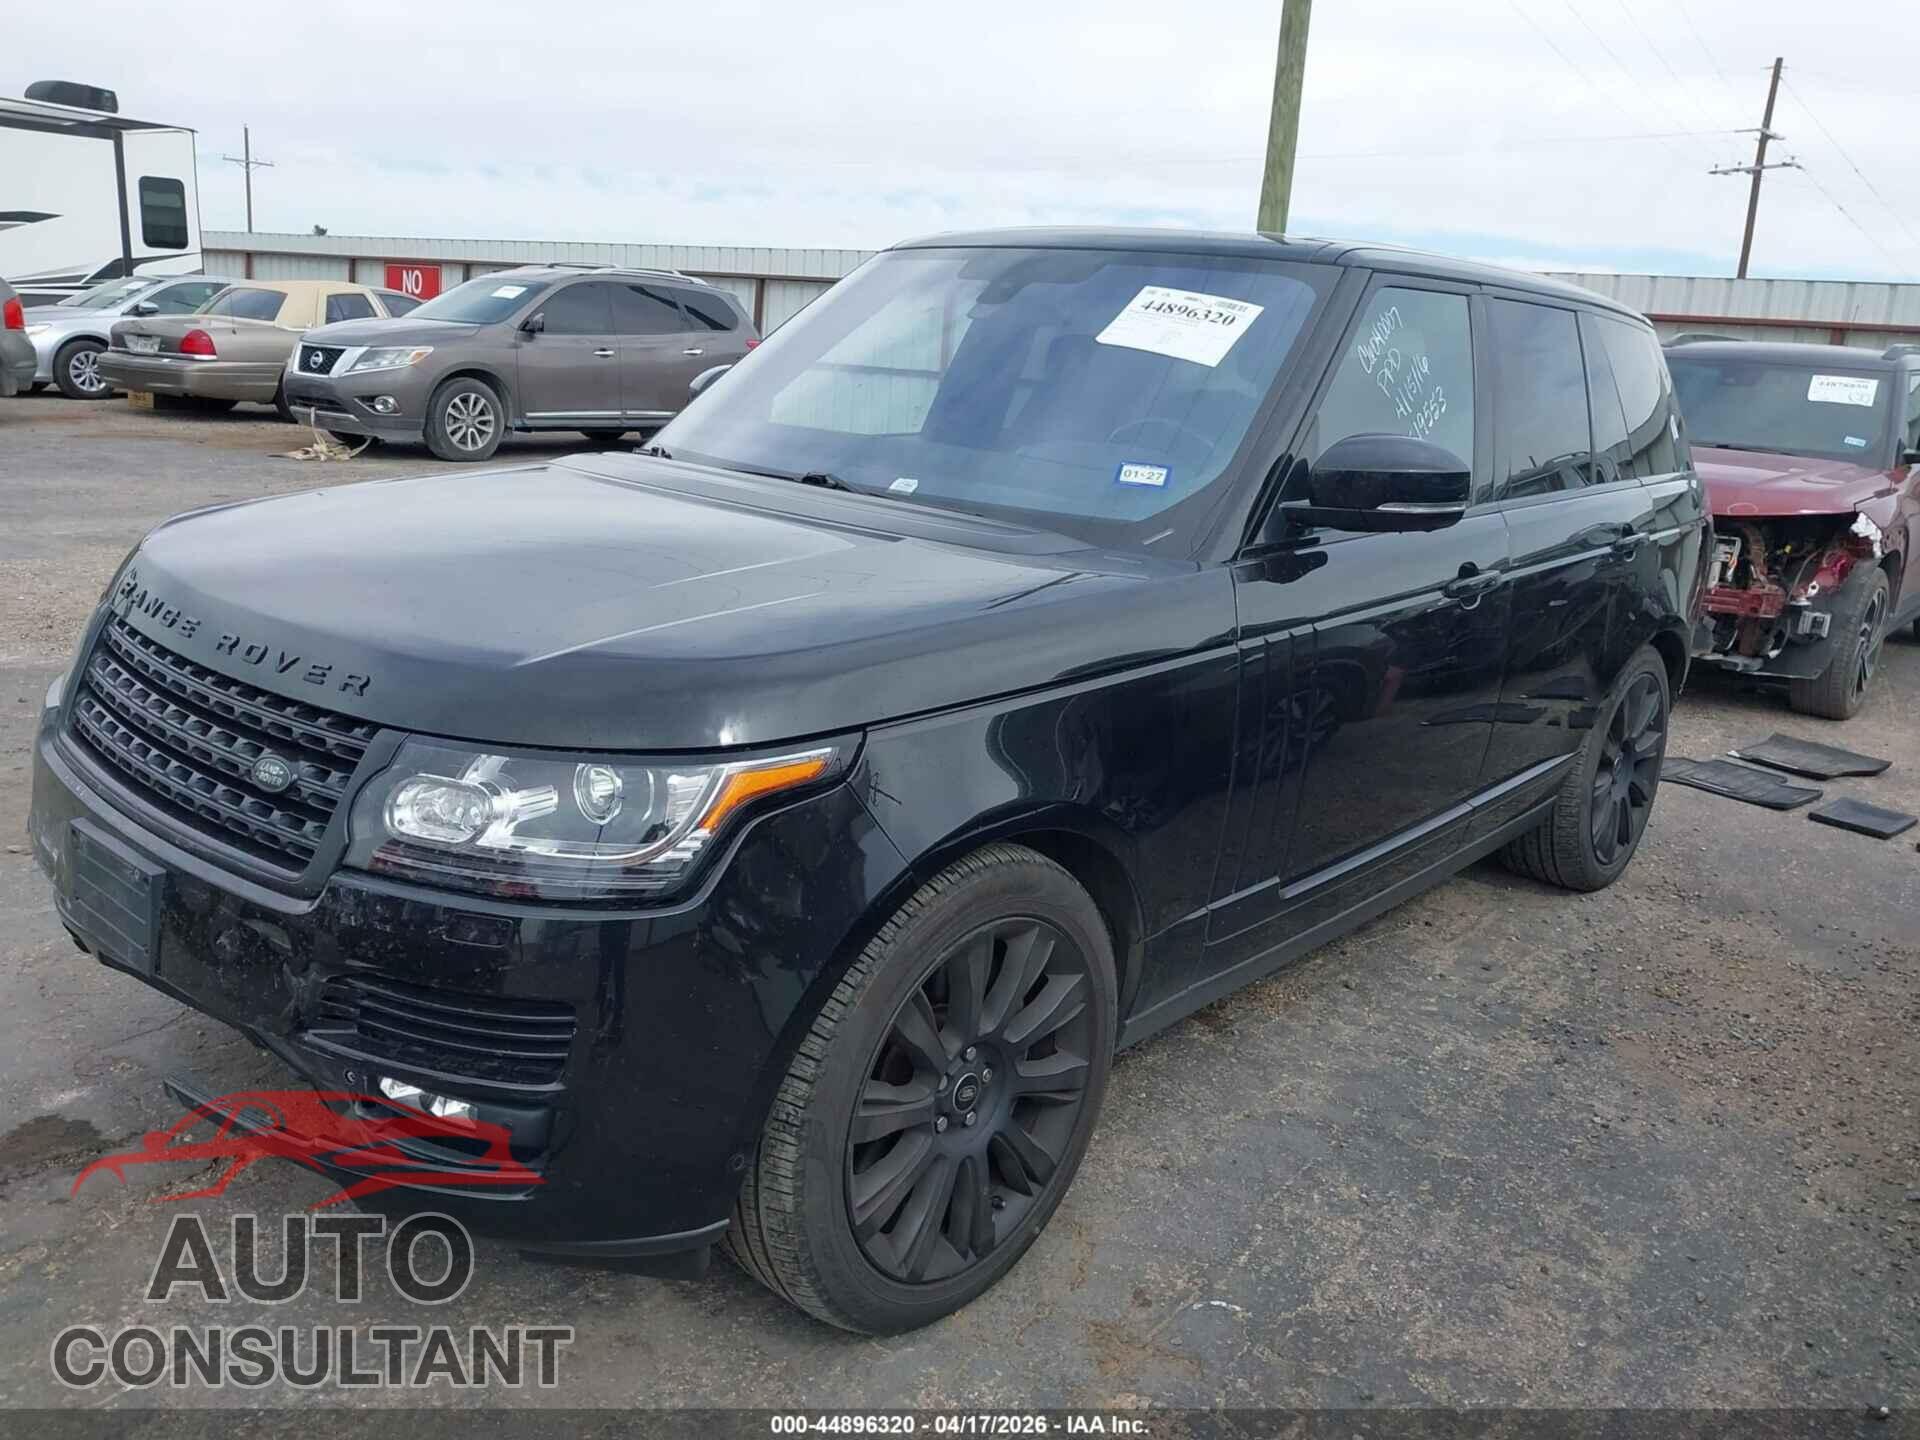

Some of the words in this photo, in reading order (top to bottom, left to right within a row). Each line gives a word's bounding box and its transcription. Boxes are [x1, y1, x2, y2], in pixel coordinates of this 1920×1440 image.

[402, 269, 423, 295] NO
[1141, 299, 1237, 327] 44896320
[1123, 468, 1164, 482] 01-27
[119, 580, 202, 640] RANGE
[215, 634, 372, 698] ROVER
